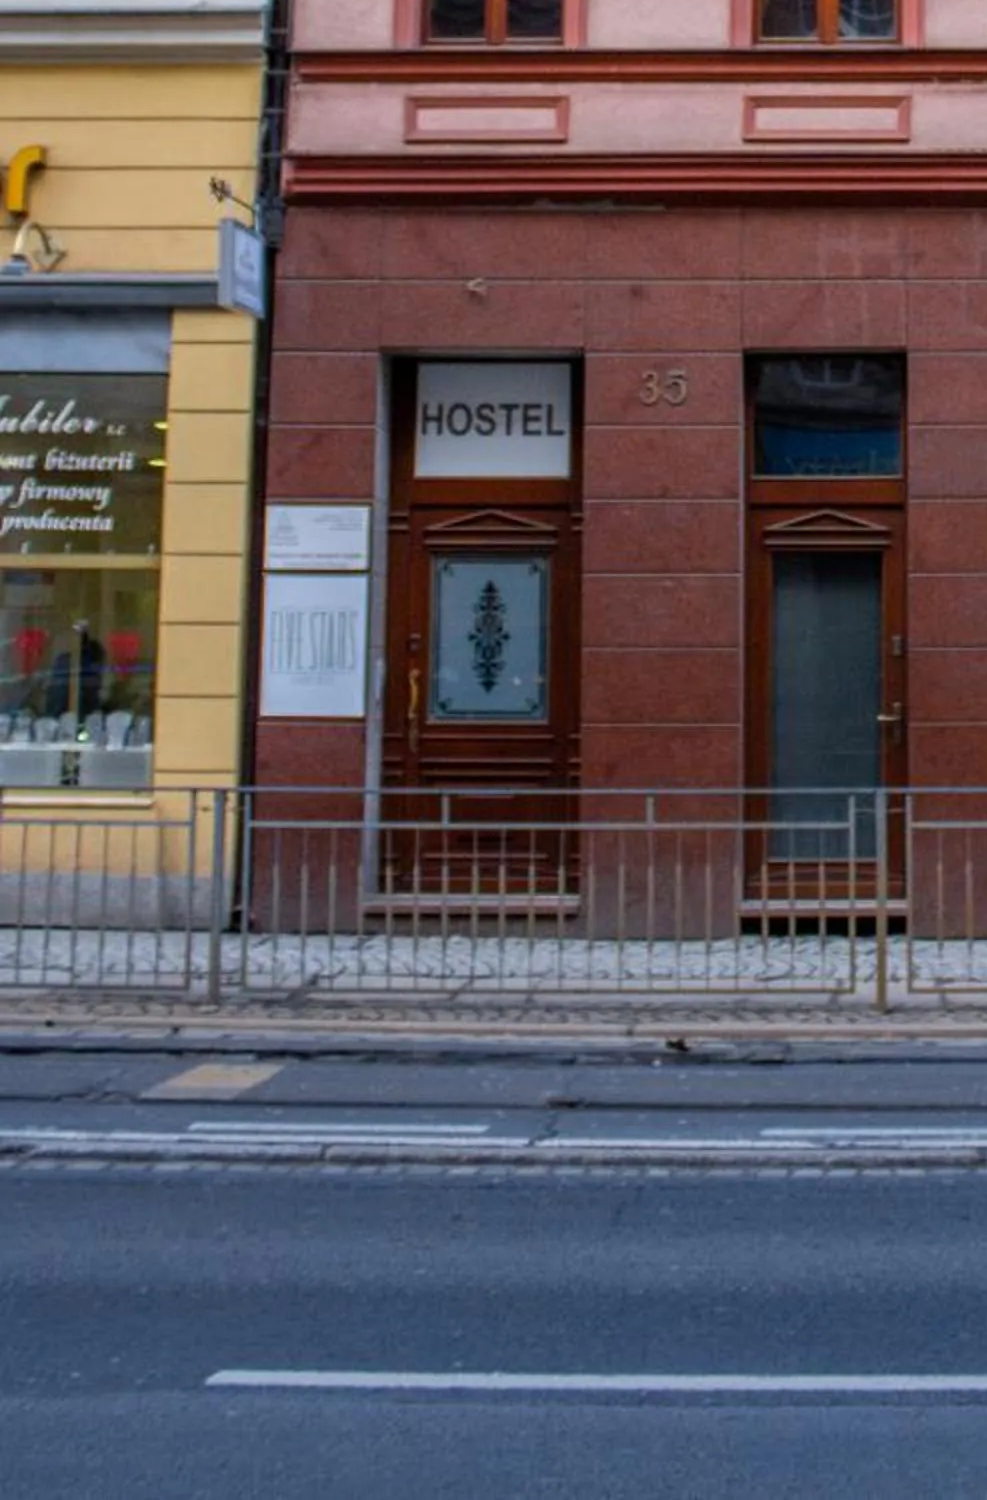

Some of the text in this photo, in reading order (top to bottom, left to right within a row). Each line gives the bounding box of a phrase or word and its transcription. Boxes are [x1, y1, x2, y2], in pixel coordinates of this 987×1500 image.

[639, 368, 688, 406] 35
[420, 403, 566, 436] HOSTEL
[9, 477, 112, 511] firmowy
[0, 508, 115, 535] producenta
